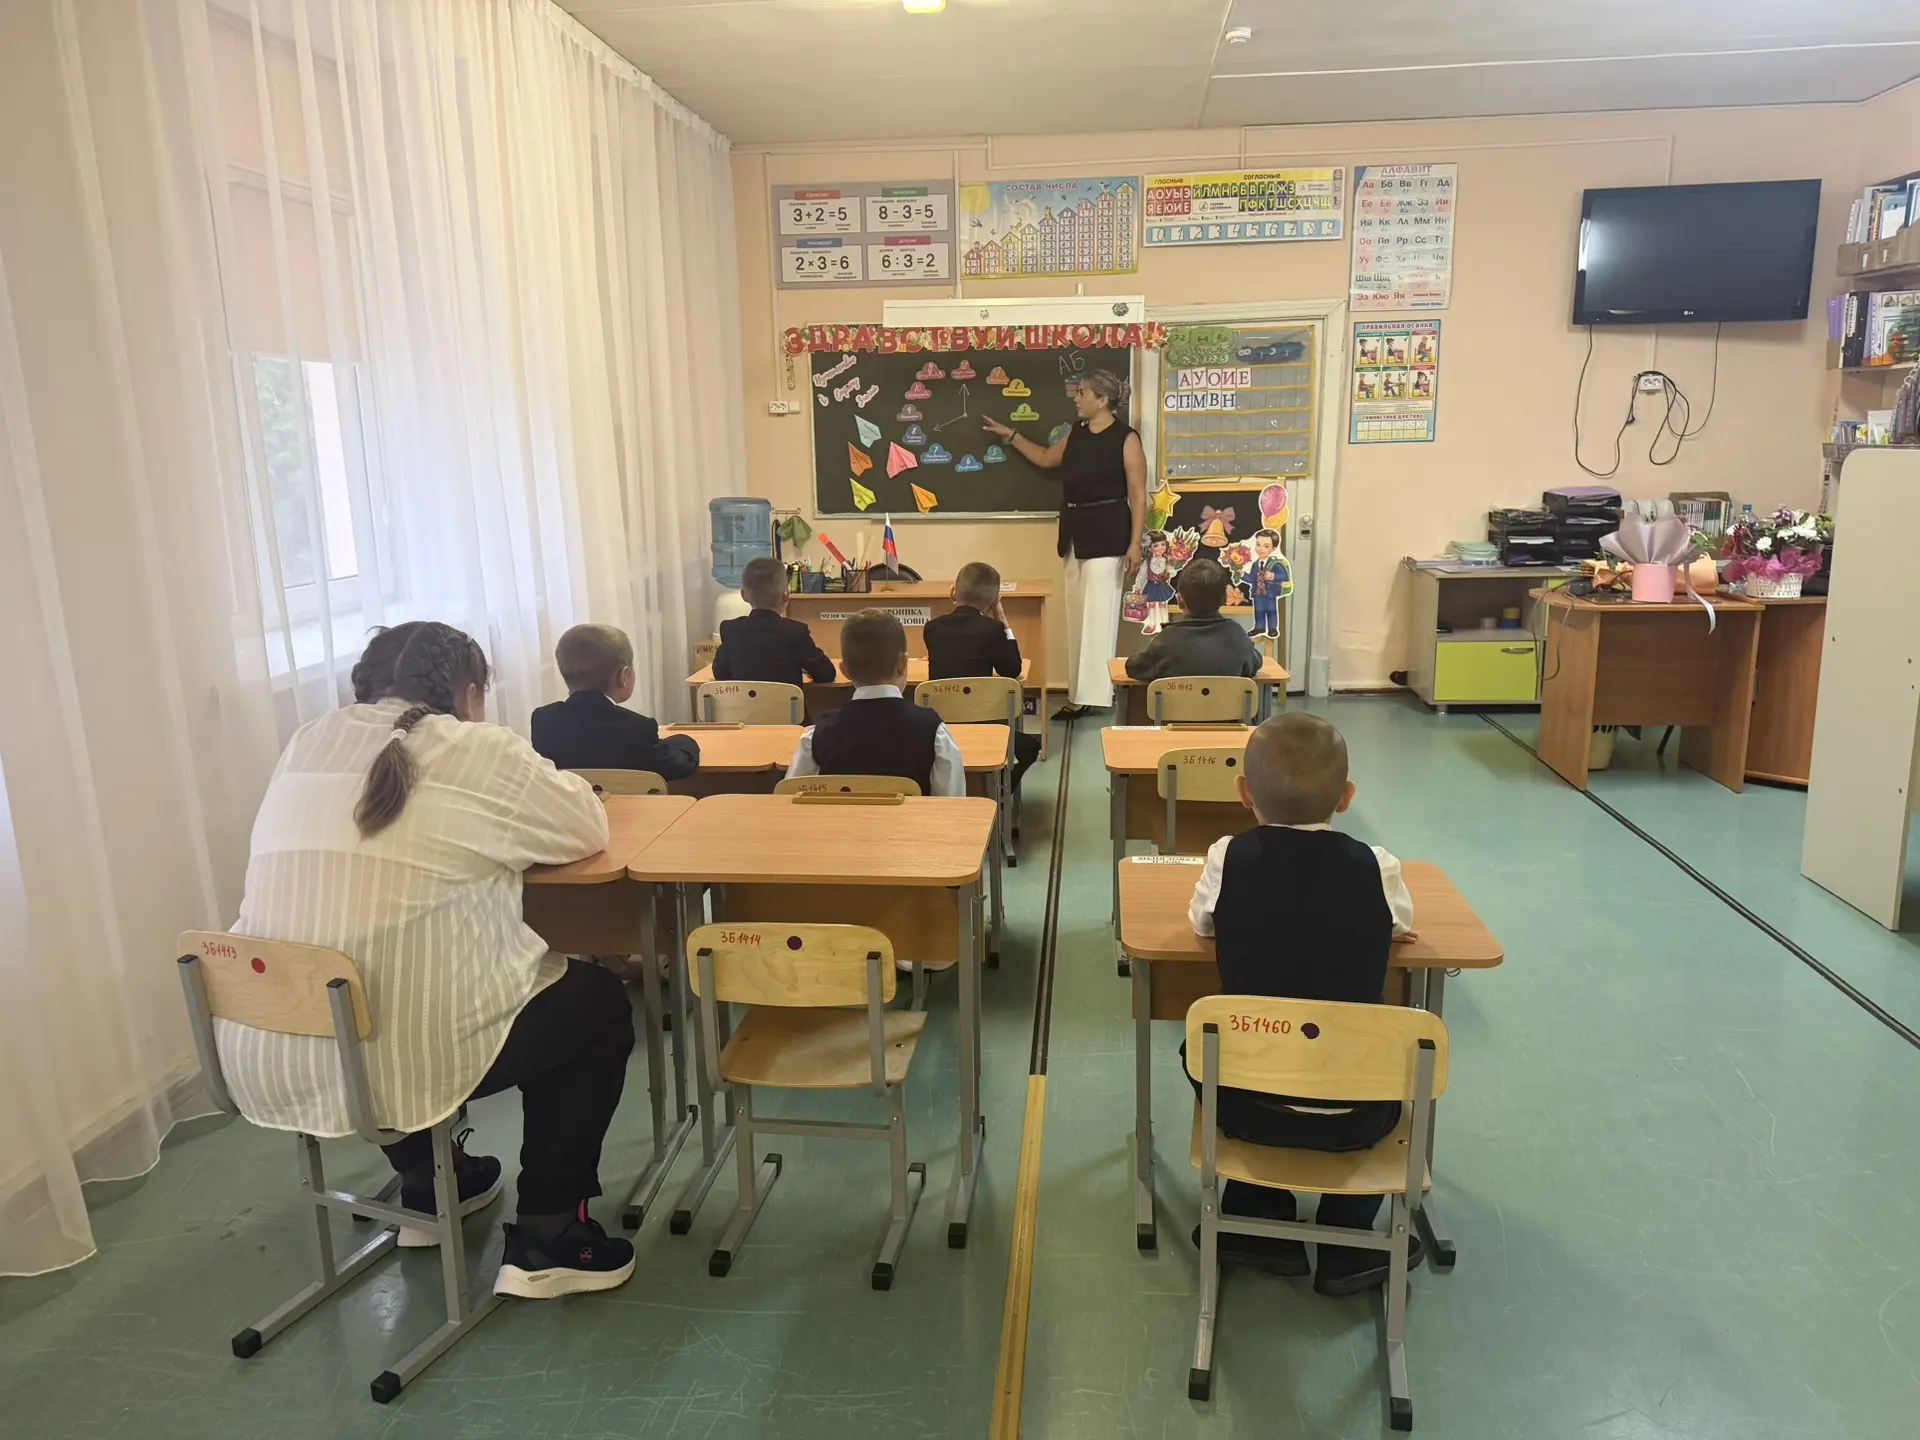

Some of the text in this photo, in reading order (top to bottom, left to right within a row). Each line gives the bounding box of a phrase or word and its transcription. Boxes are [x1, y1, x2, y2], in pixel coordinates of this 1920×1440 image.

[1381, 165, 1432, 174] АЛФАВИТ
[1436, 179, 1450, 187] Дд
[1005, 184, 1042, 192] СОСТАВ
[1396, 237, 1408, 245] Рр
[1058, 350, 1084, 375] АБ
